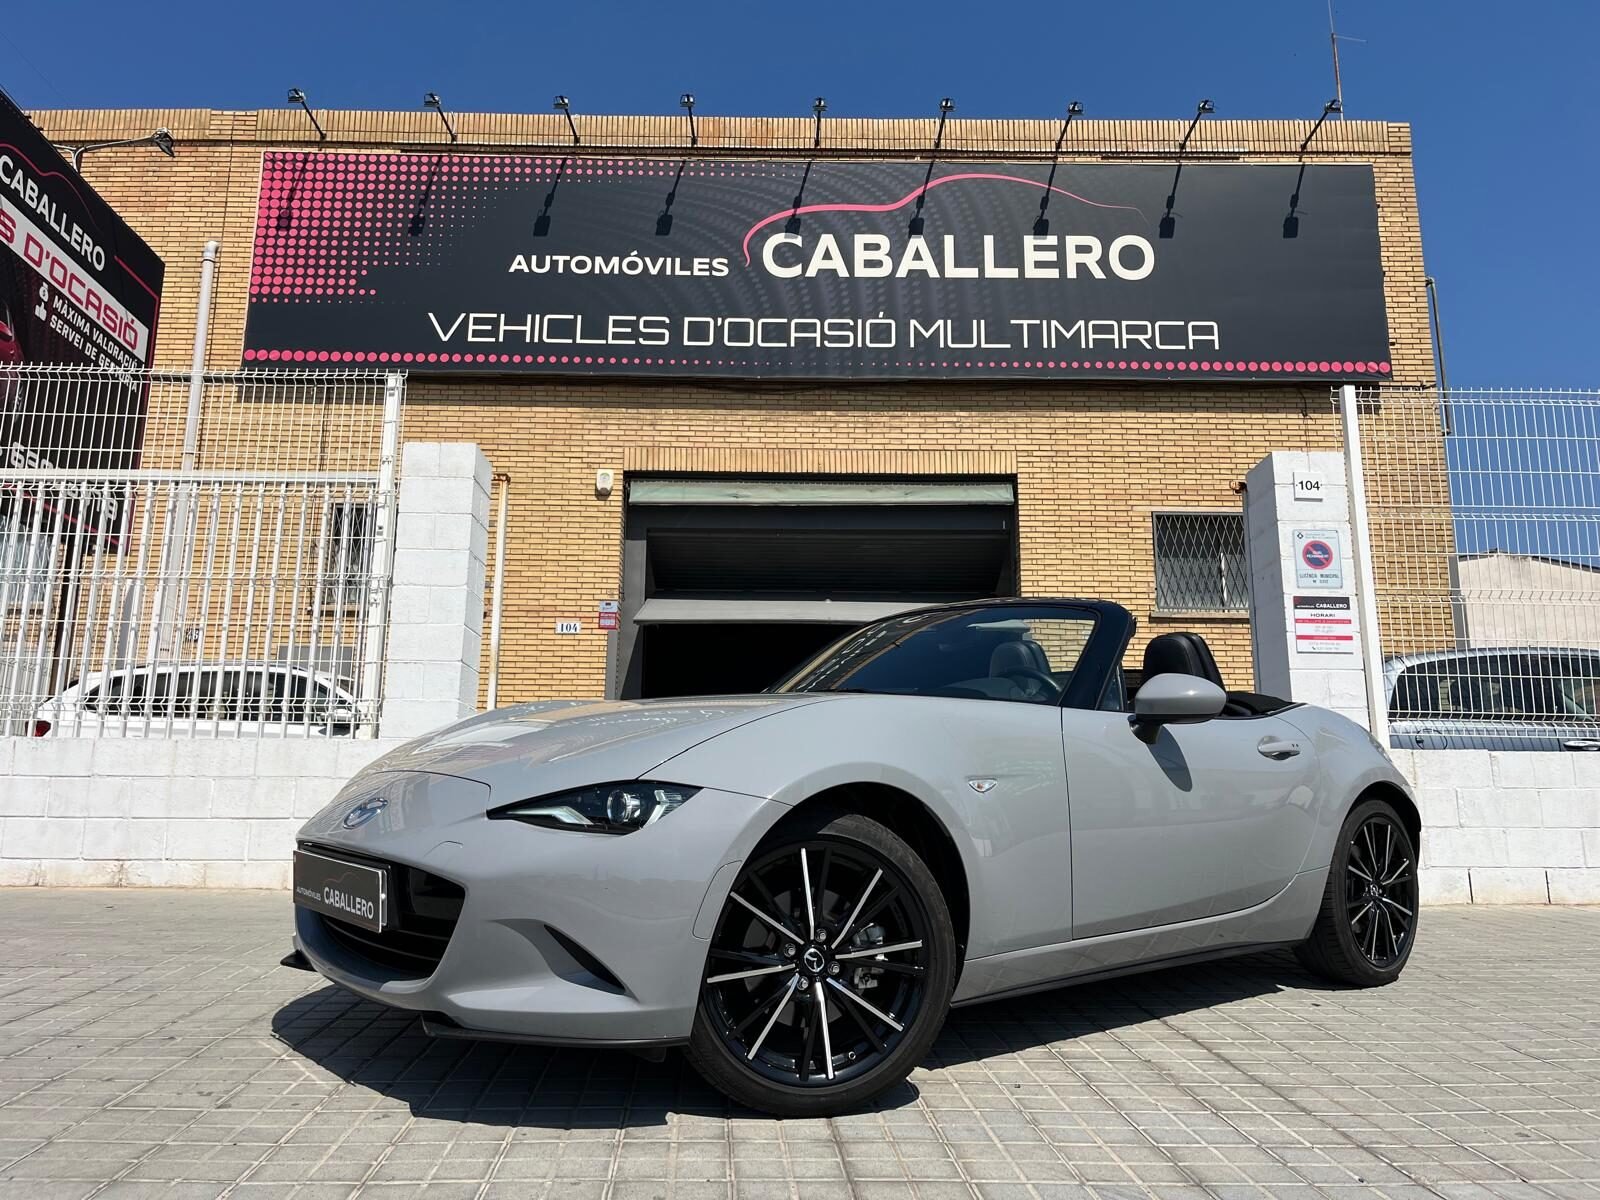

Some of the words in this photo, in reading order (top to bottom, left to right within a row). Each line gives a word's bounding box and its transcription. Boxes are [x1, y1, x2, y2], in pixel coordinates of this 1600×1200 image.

[0, 154, 106, 271] CABALLERO
[508, 250, 730, 277] AUTOMÓVILES
[762, 232, 1156, 281] CABALLERO
[24, 232, 139, 351] D'OCASIÓ
[53, 295, 90, 336] MÀXIMA
[428, 312, 671, 346] VEHICLES
[683, 311, 896, 348] D'OCASIÓ
[909, 319, 1220, 350] MULTIMARCA
[50, 315, 84, 350] SERVEI
[84, 342, 98, 361] DE
[1298, 480, 1321, 491] 104
[560, 623, 578, 633] 104
[323, 886, 374, 920] CABALLERO
